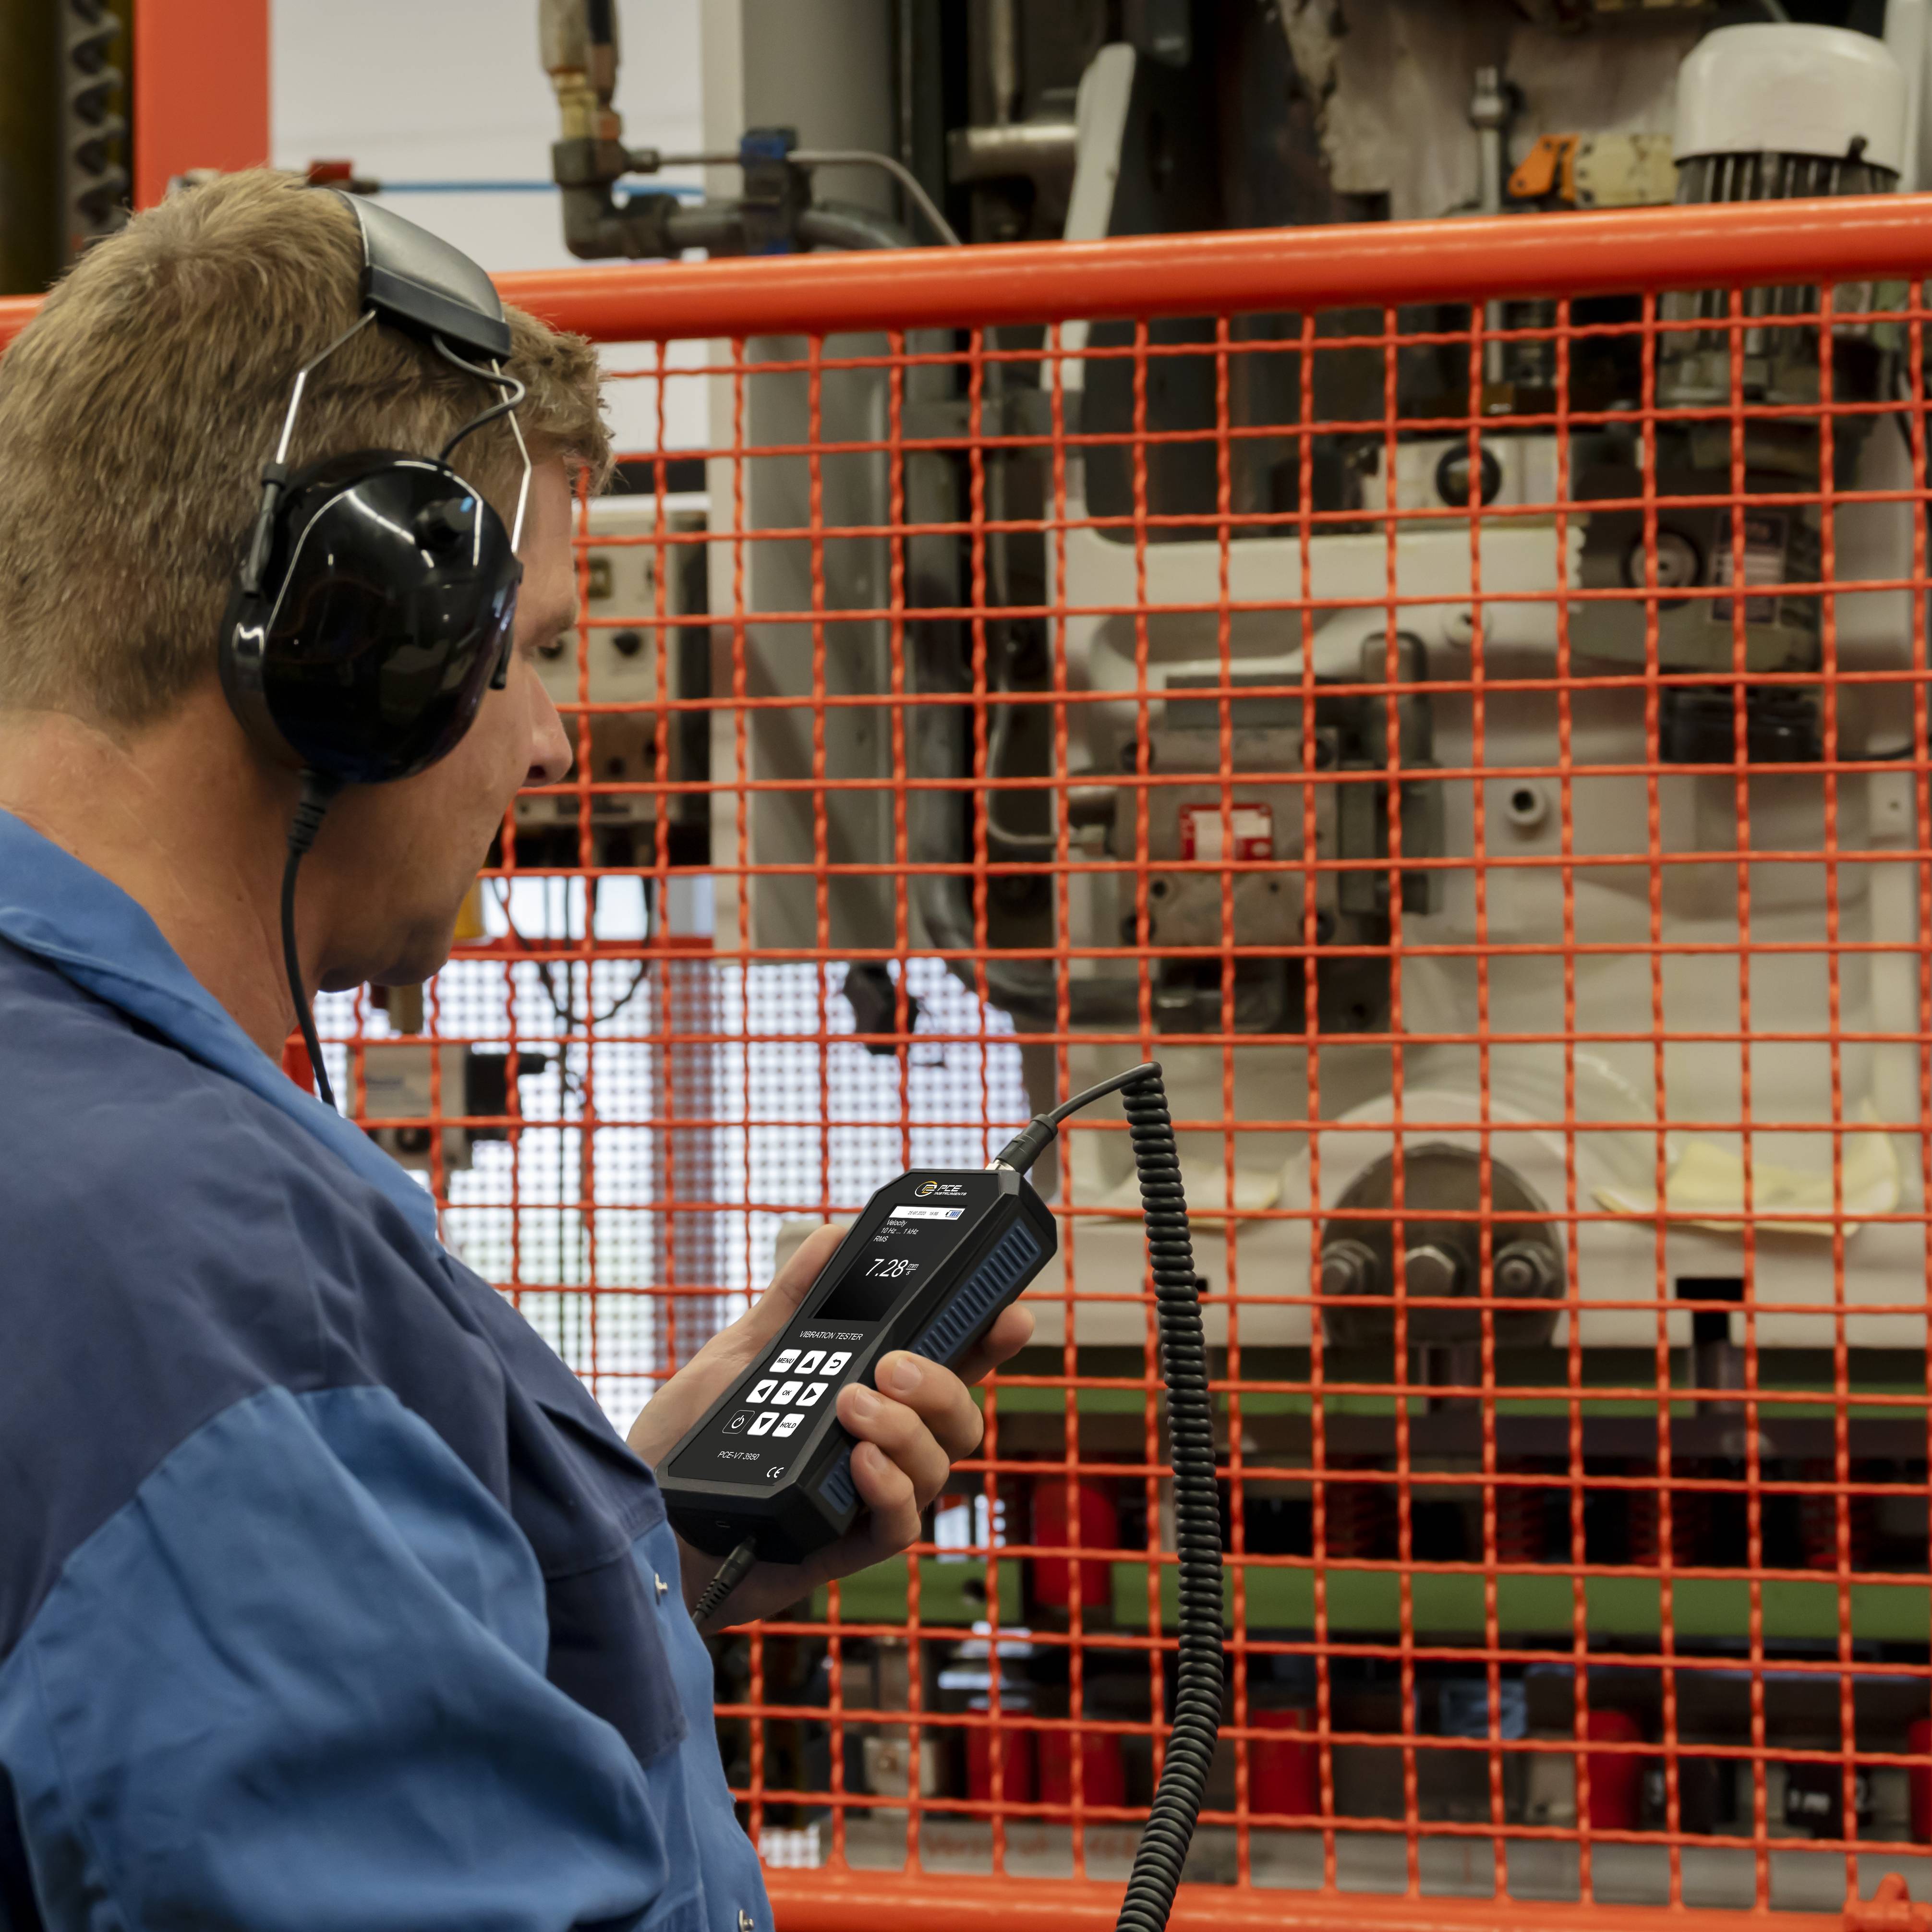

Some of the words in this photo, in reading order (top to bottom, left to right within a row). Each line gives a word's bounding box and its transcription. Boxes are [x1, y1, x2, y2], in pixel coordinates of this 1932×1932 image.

[865, 1258, 909, 1278] 7.28
[835, 1332, 863, 1340] TESTER
[717, 1451, 745, 1459] PCE-VT
